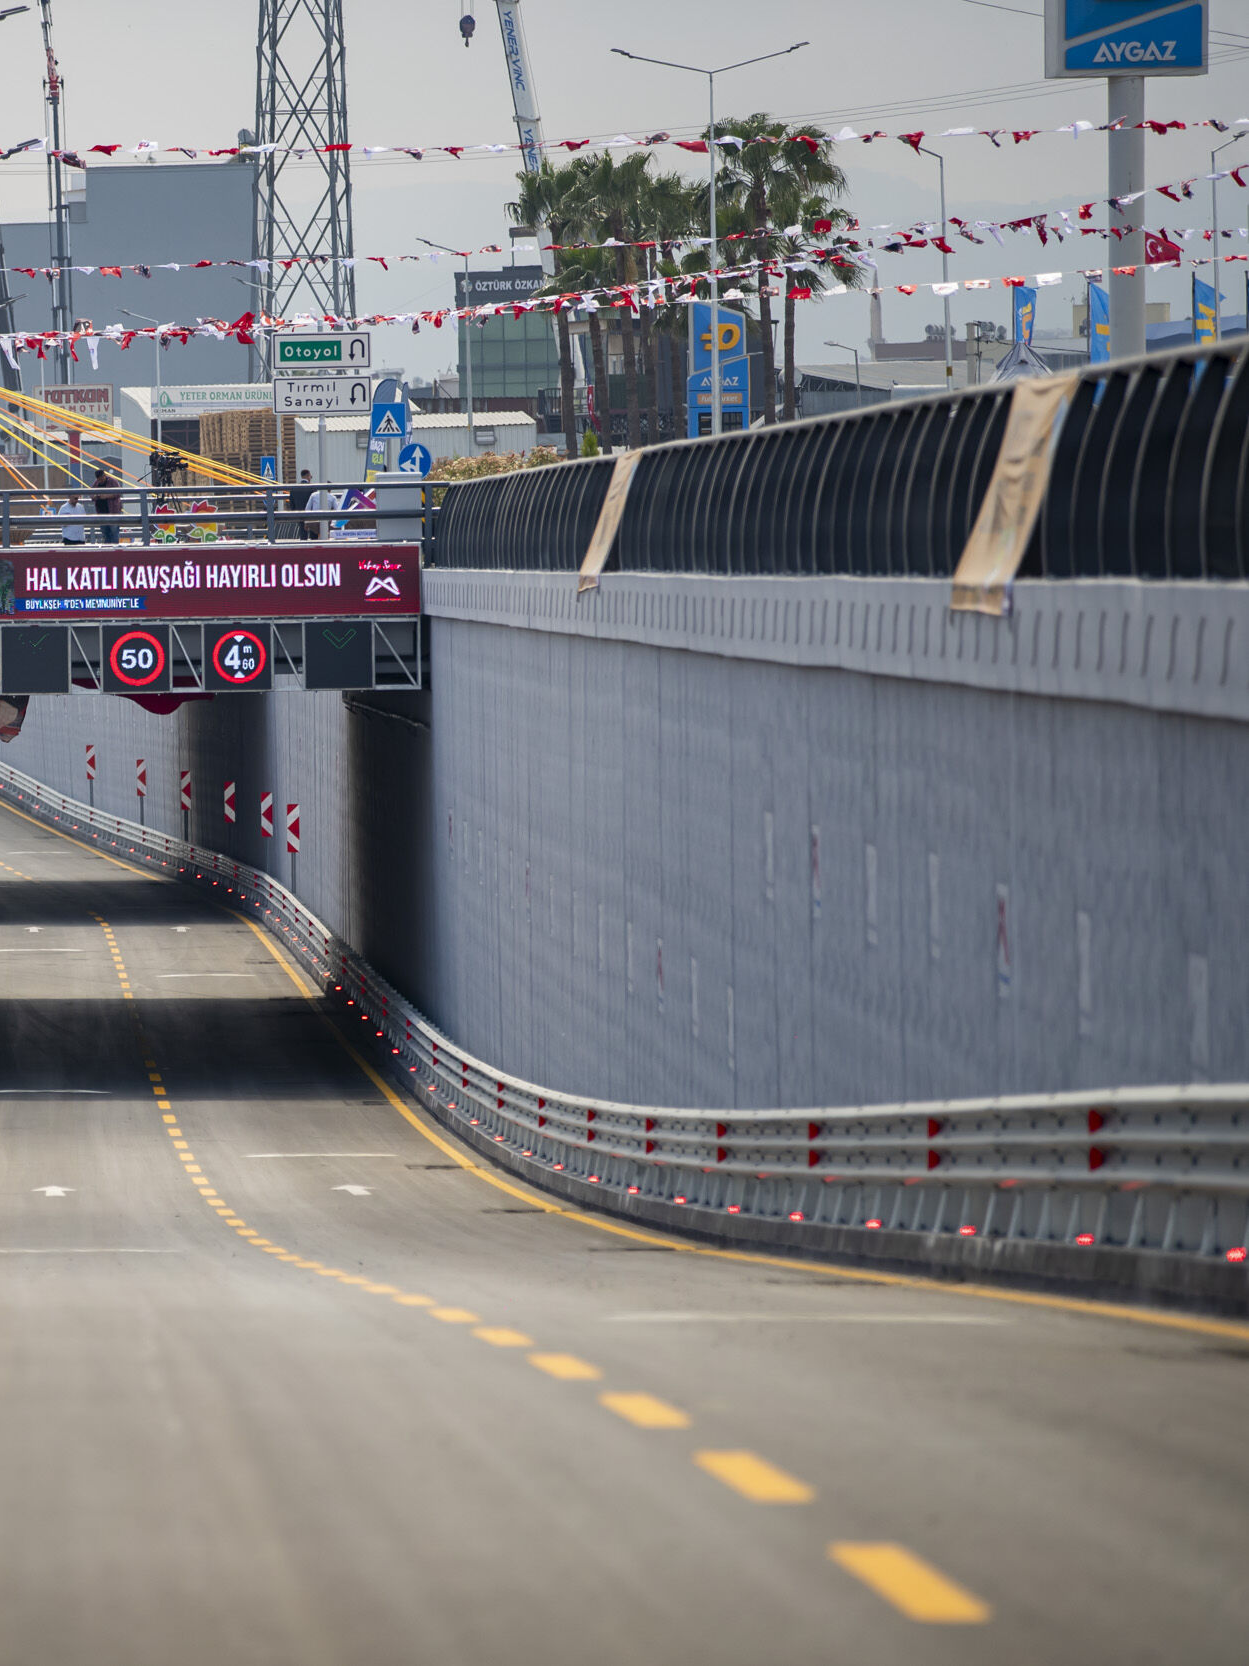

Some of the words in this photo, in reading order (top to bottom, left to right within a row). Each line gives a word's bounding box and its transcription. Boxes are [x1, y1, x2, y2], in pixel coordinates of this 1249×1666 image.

[503, 10, 519, 58] YENER
[1093, 40, 1177, 62] AYGAZ
[475, 278, 512, 292] ÖZTÜRK
[284, 345, 338, 360] Otoyol
[287, 381, 336, 393] Tırmıl
[700, 376, 739, 387] AAZ
[180, 391, 207, 401] YETER
[210, 391, 242, 401] ORMAN
[244, 389, 273, 400] ÜRÜNL
[284, 396, 339, 408] Sanayi
[26, 567, 62, 591] HAL
[67, 566, 117, 590] KATLI
[123, 561, 200, 593] KAVŞAĞI
[206, 564, 276, 589] HAYIRLI
[281, 563, 341, 588] OLSUN
[121, 648, 154, 670] 50
[224, 644, 242, 670] 4
[243, 645, 253, 654] m
[242, 658, 256, 671] 60
